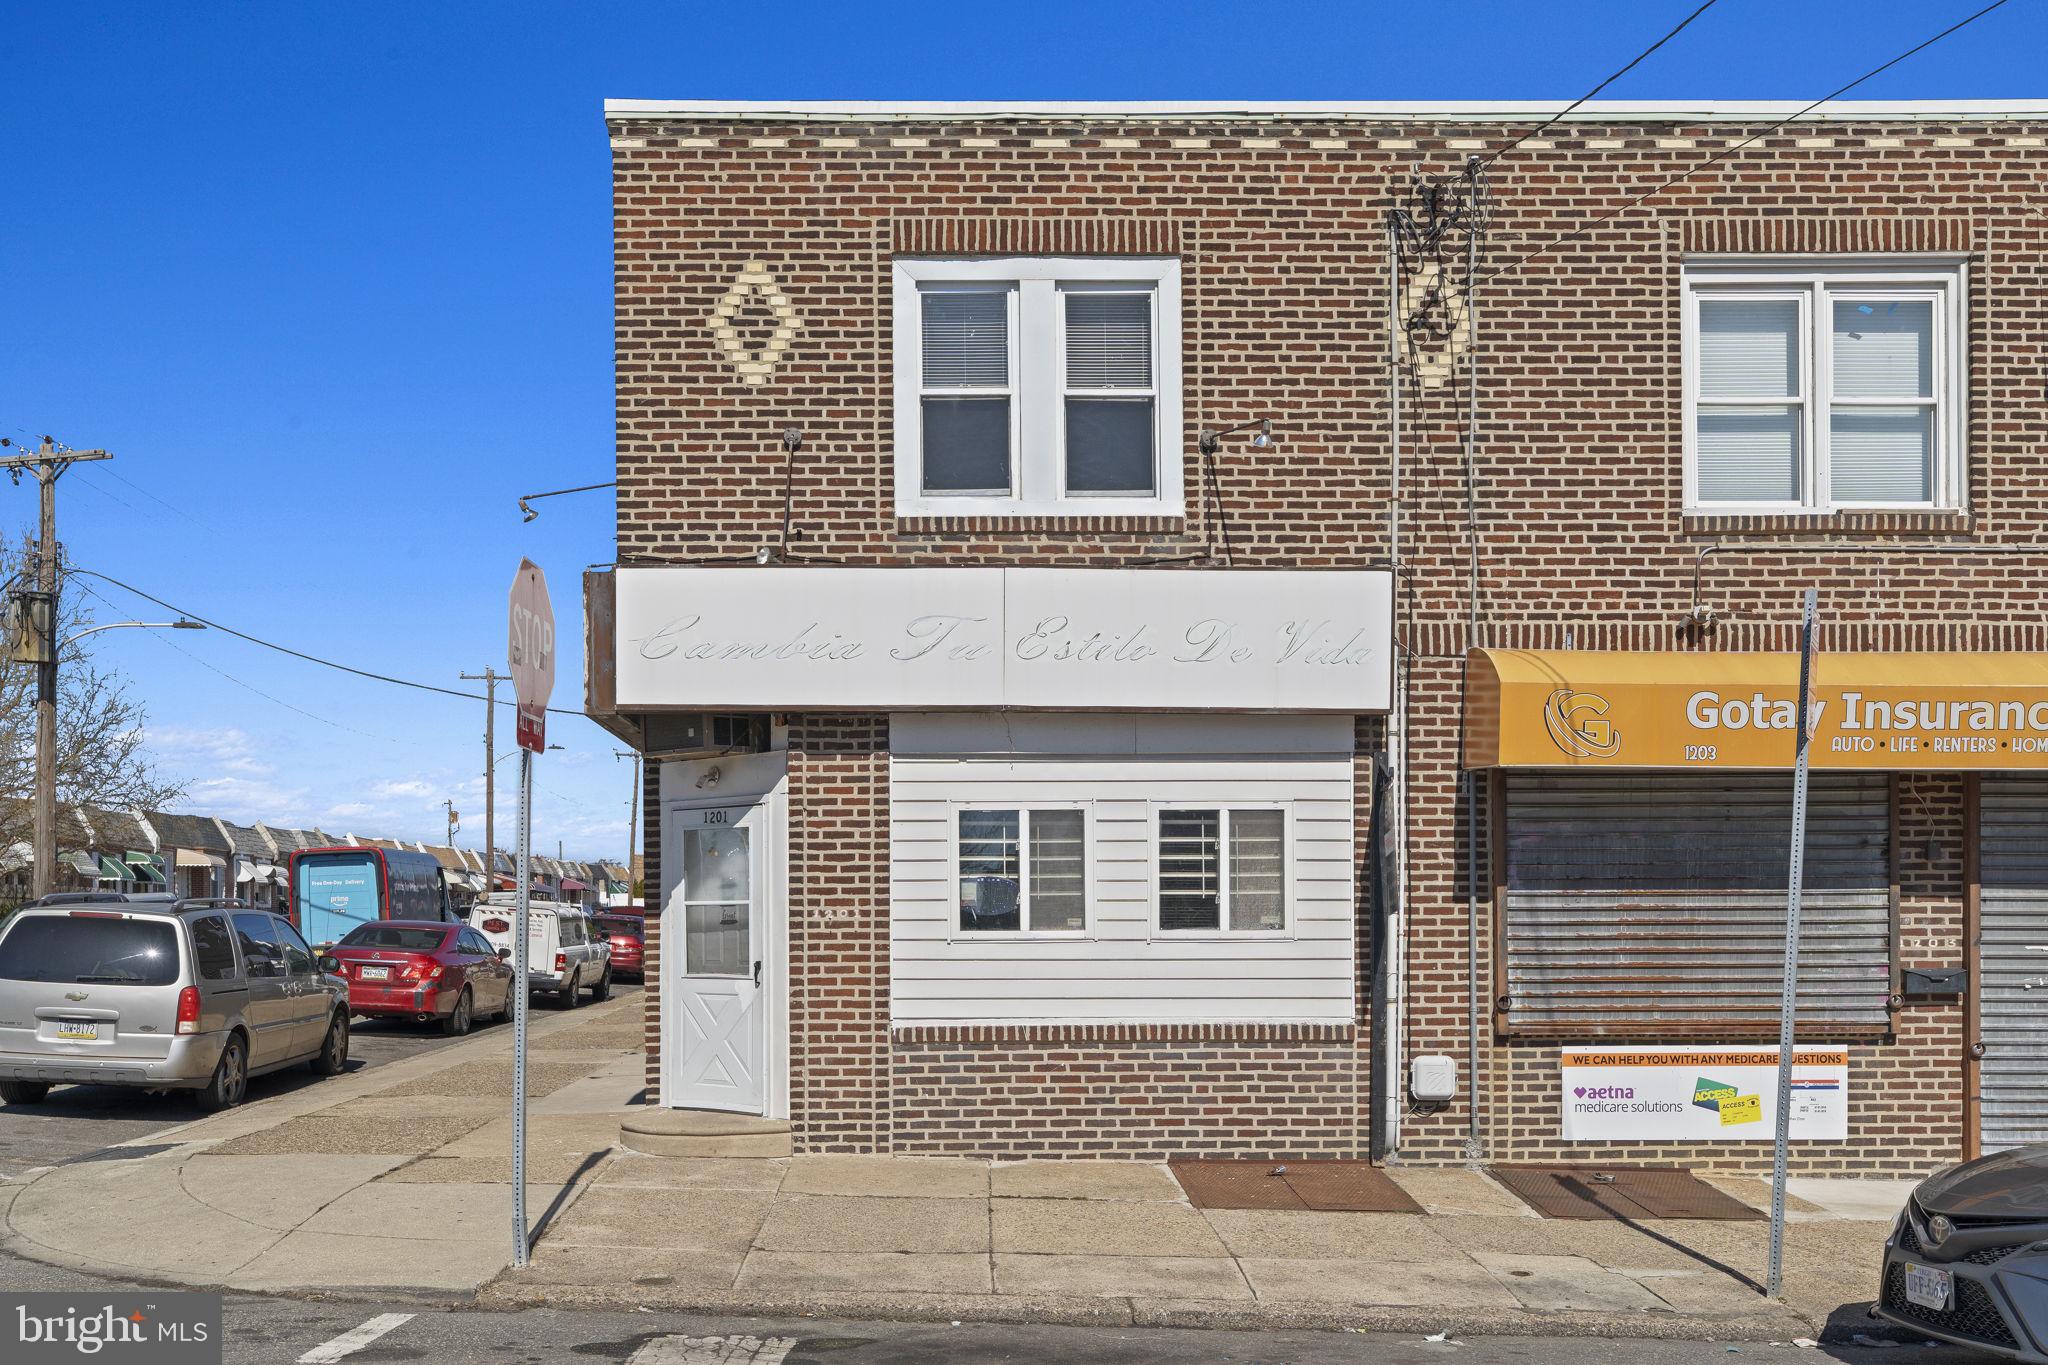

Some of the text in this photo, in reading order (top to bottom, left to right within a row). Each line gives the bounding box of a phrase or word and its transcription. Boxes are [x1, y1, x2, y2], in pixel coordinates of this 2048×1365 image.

[513, 603, 552, 671] STOP
[628, 614, 1379, 665] Cambia Tu Estilo De Vida
[1840, 691, 2048, 731] Insuranc
[519, 713, 529, 732] ALL
[1831, 736, 2048, 753] AUTO LIFE RENTERS HOM
[1684, 745, 1717, 760] 1203
[704, 810, 728, 824] 1201
[812, 909, 862, 919] 1201
[1573, 1054, 1842, 1065] WE CAN HELP YOU WITH ANY MEDICARE UESTIONS
[1587, 1085, 1635, 1099] aetna
[1694, 1087, 1736, 1102] ACCESS
[1574, 1101, 1683, 1113] medicare solutions
[1722, 1101, 1746, 1109] ACCESS
